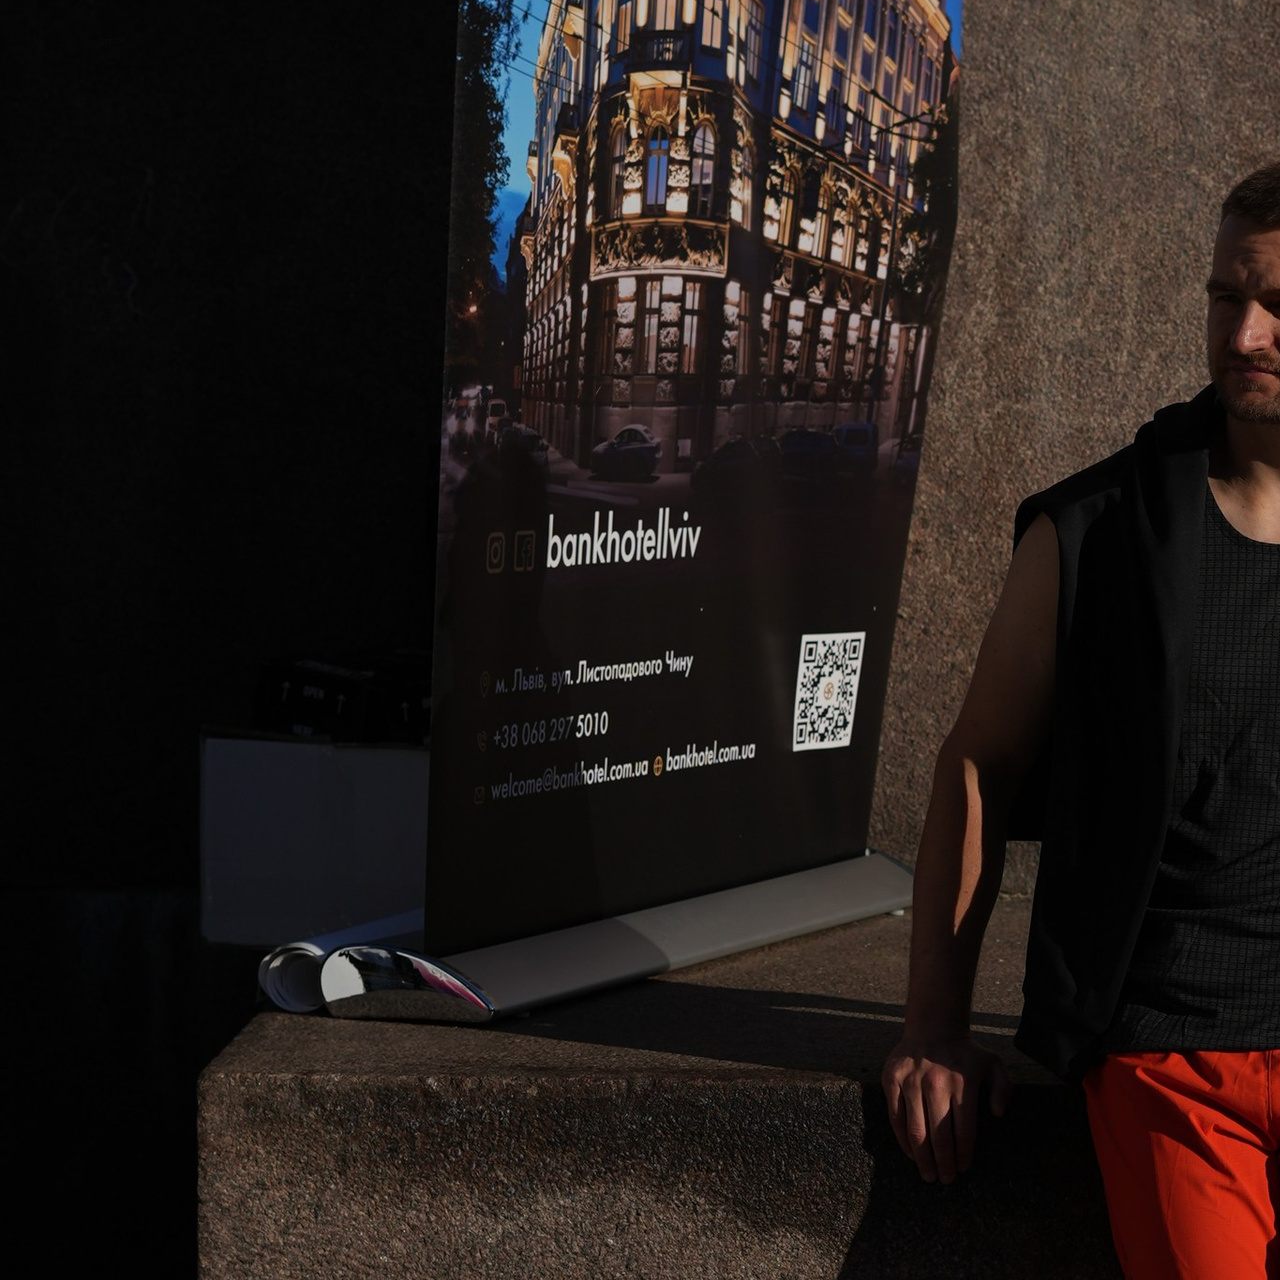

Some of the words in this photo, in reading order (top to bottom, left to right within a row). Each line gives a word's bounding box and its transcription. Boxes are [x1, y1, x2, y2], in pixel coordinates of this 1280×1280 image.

[546, 507, 702, 569] bankhotellviv
[511, 667, 547, 693] Львів,
[551, 669, 574, 693] вул.
[576, 659, 663, 685] Листопадового
[665, 650, 694, 679] Чину
[493, 724, 518, 749] +38
[521, 722, 546, 746] 068
[549, 716, 574, 743] 297
[575, 710, 609, 739] 5010
[490, 757, 649, 800] welcome@bankhotel.com.ua
[665, 739, 757, 773] bankhotel.com.ua
